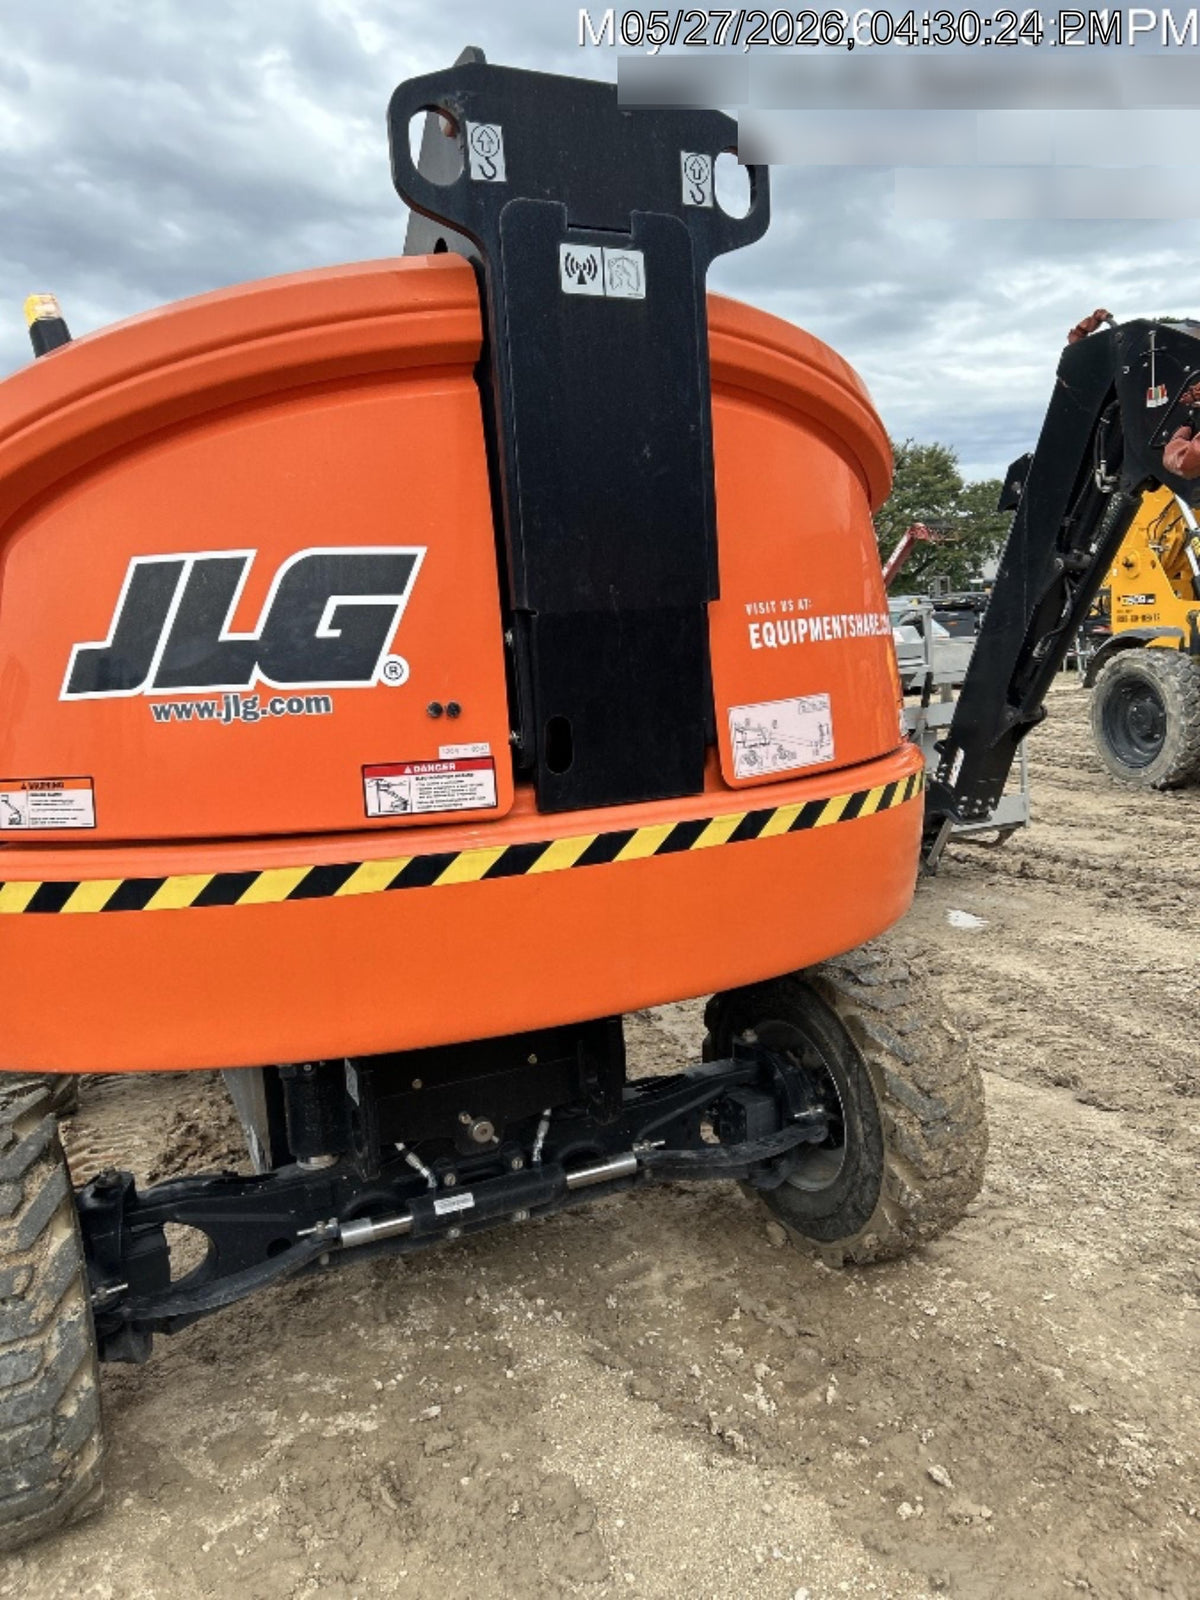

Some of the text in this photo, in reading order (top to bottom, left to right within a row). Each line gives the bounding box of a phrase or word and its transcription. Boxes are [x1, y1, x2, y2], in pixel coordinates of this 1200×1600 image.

[745, 598, 813, 616] VISIT US AT:
[59, 546, 427, 701] JLG
[150, 693, 332, 725] www.jlg.com
[413, 763, 456, 773] DANGER
